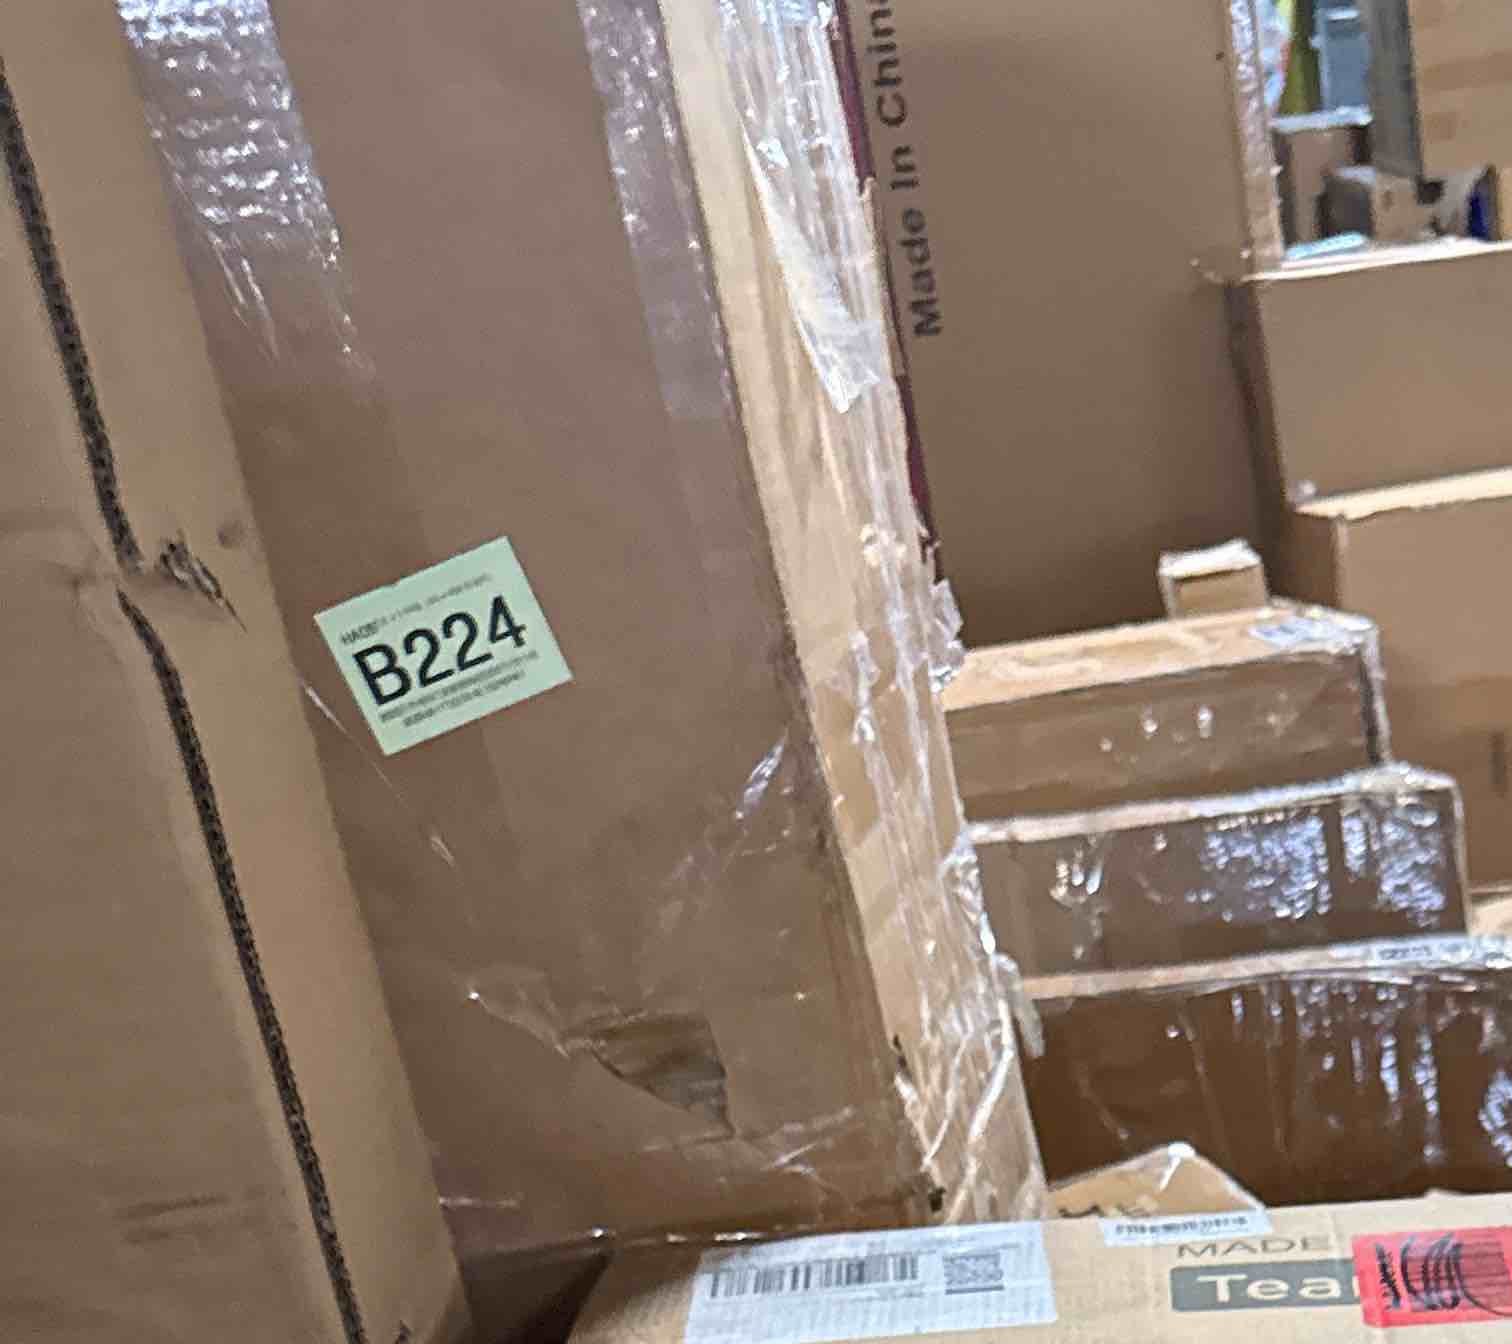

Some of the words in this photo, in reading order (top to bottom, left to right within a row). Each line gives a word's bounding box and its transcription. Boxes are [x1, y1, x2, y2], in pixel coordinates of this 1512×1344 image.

[866, 0, 909, 129] Chin
[902, 206, 943, 340] Made
[352, 595, 528, 707] B224
[1177, 1236, 1331, 1258] MADE
